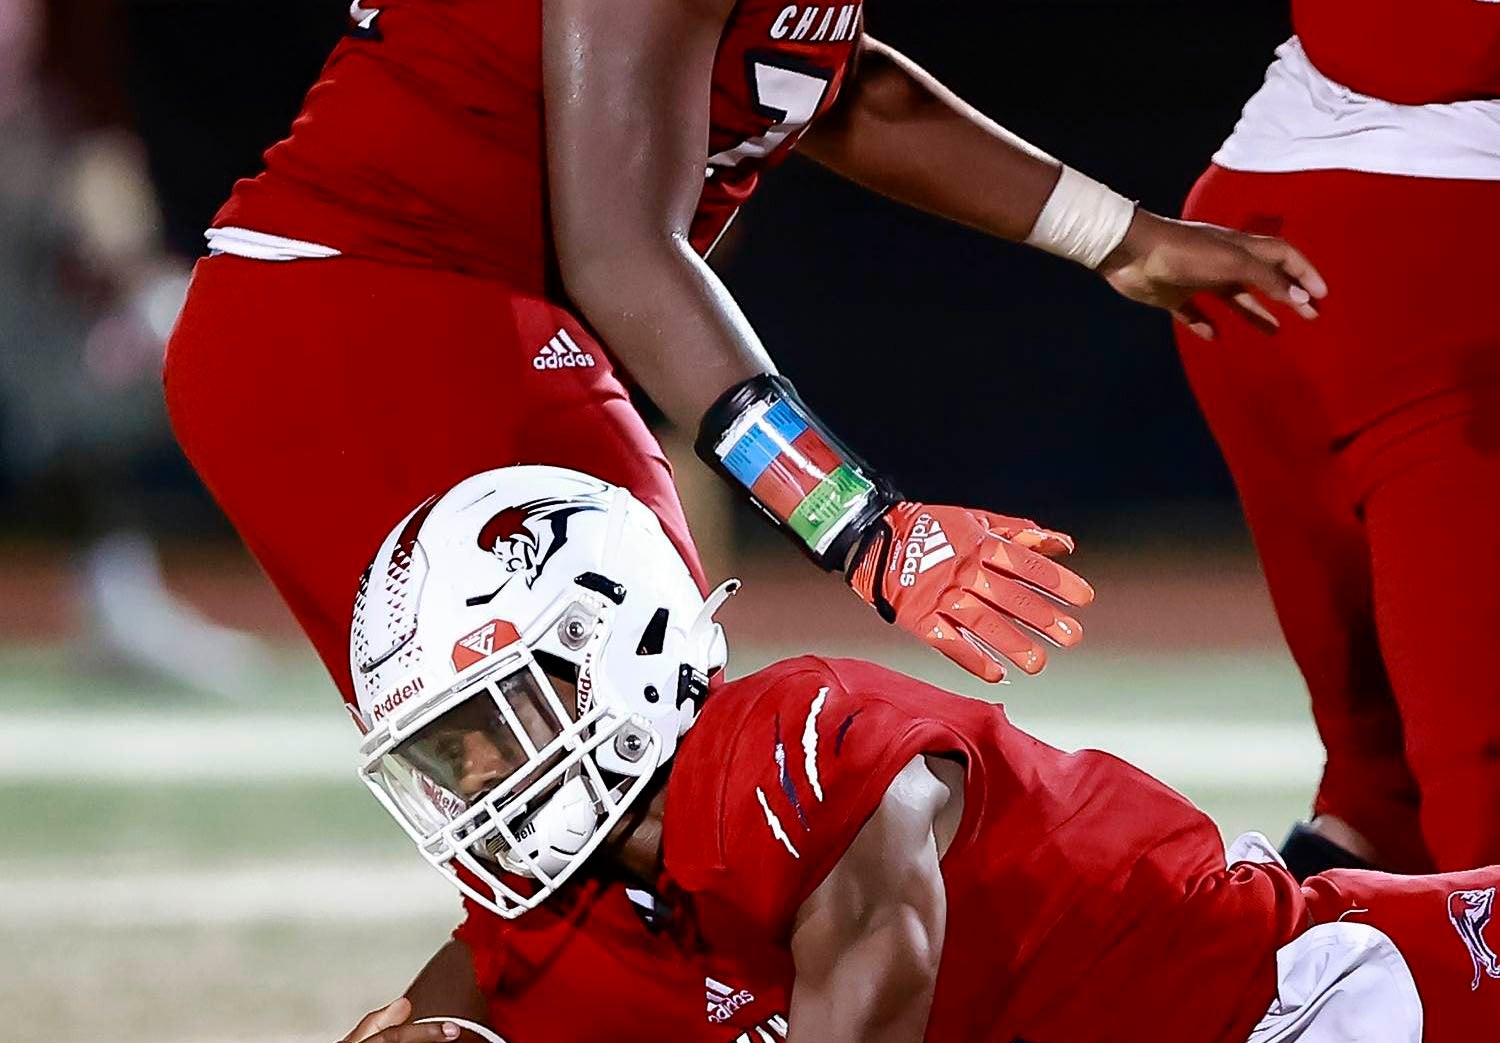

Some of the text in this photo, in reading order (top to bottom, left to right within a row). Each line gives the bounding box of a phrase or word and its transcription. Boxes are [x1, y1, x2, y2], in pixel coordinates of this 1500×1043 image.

[533, 352, 595, 370] adidas
[373, 676, 424, 721] Riddell
[708, 989, 755, 1023] adidas
